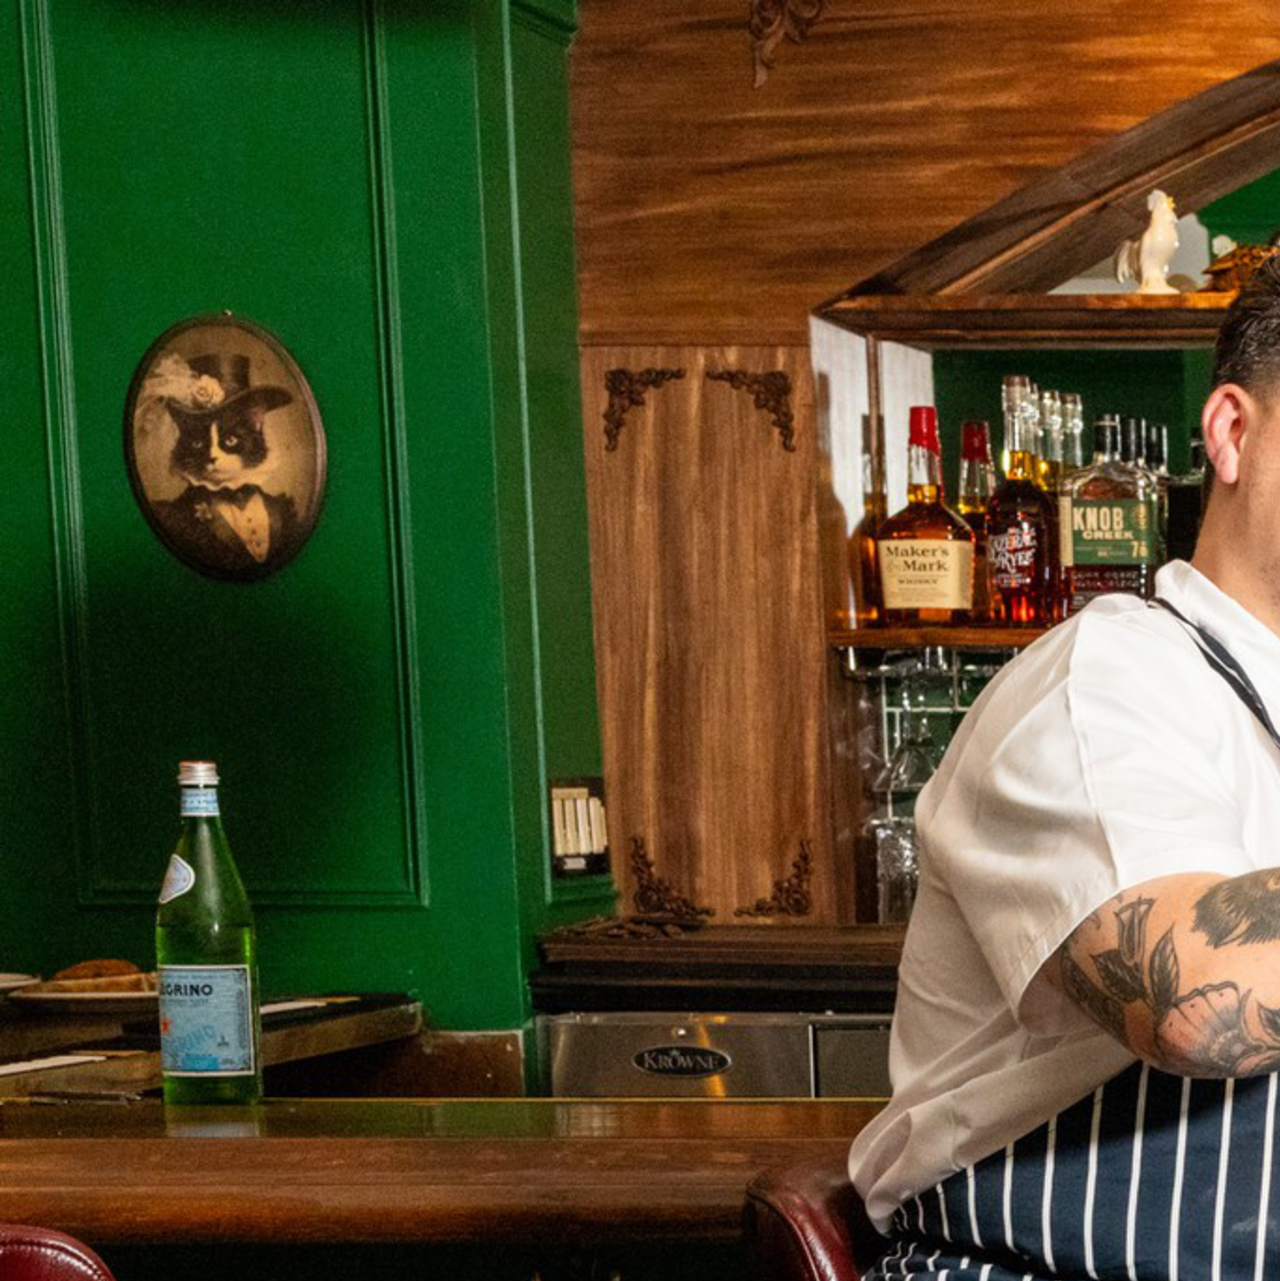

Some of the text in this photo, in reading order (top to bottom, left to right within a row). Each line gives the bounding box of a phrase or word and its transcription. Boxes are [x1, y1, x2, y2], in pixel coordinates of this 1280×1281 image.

[1073, 506, 1124, 531] KNOB
[1082, 531, 1134, 541] CREEK
[886, 545, 949, 558] Maker's
[903, 560, 949, 572] Mark
[644, 1052, 719, 1069] KROWNE
